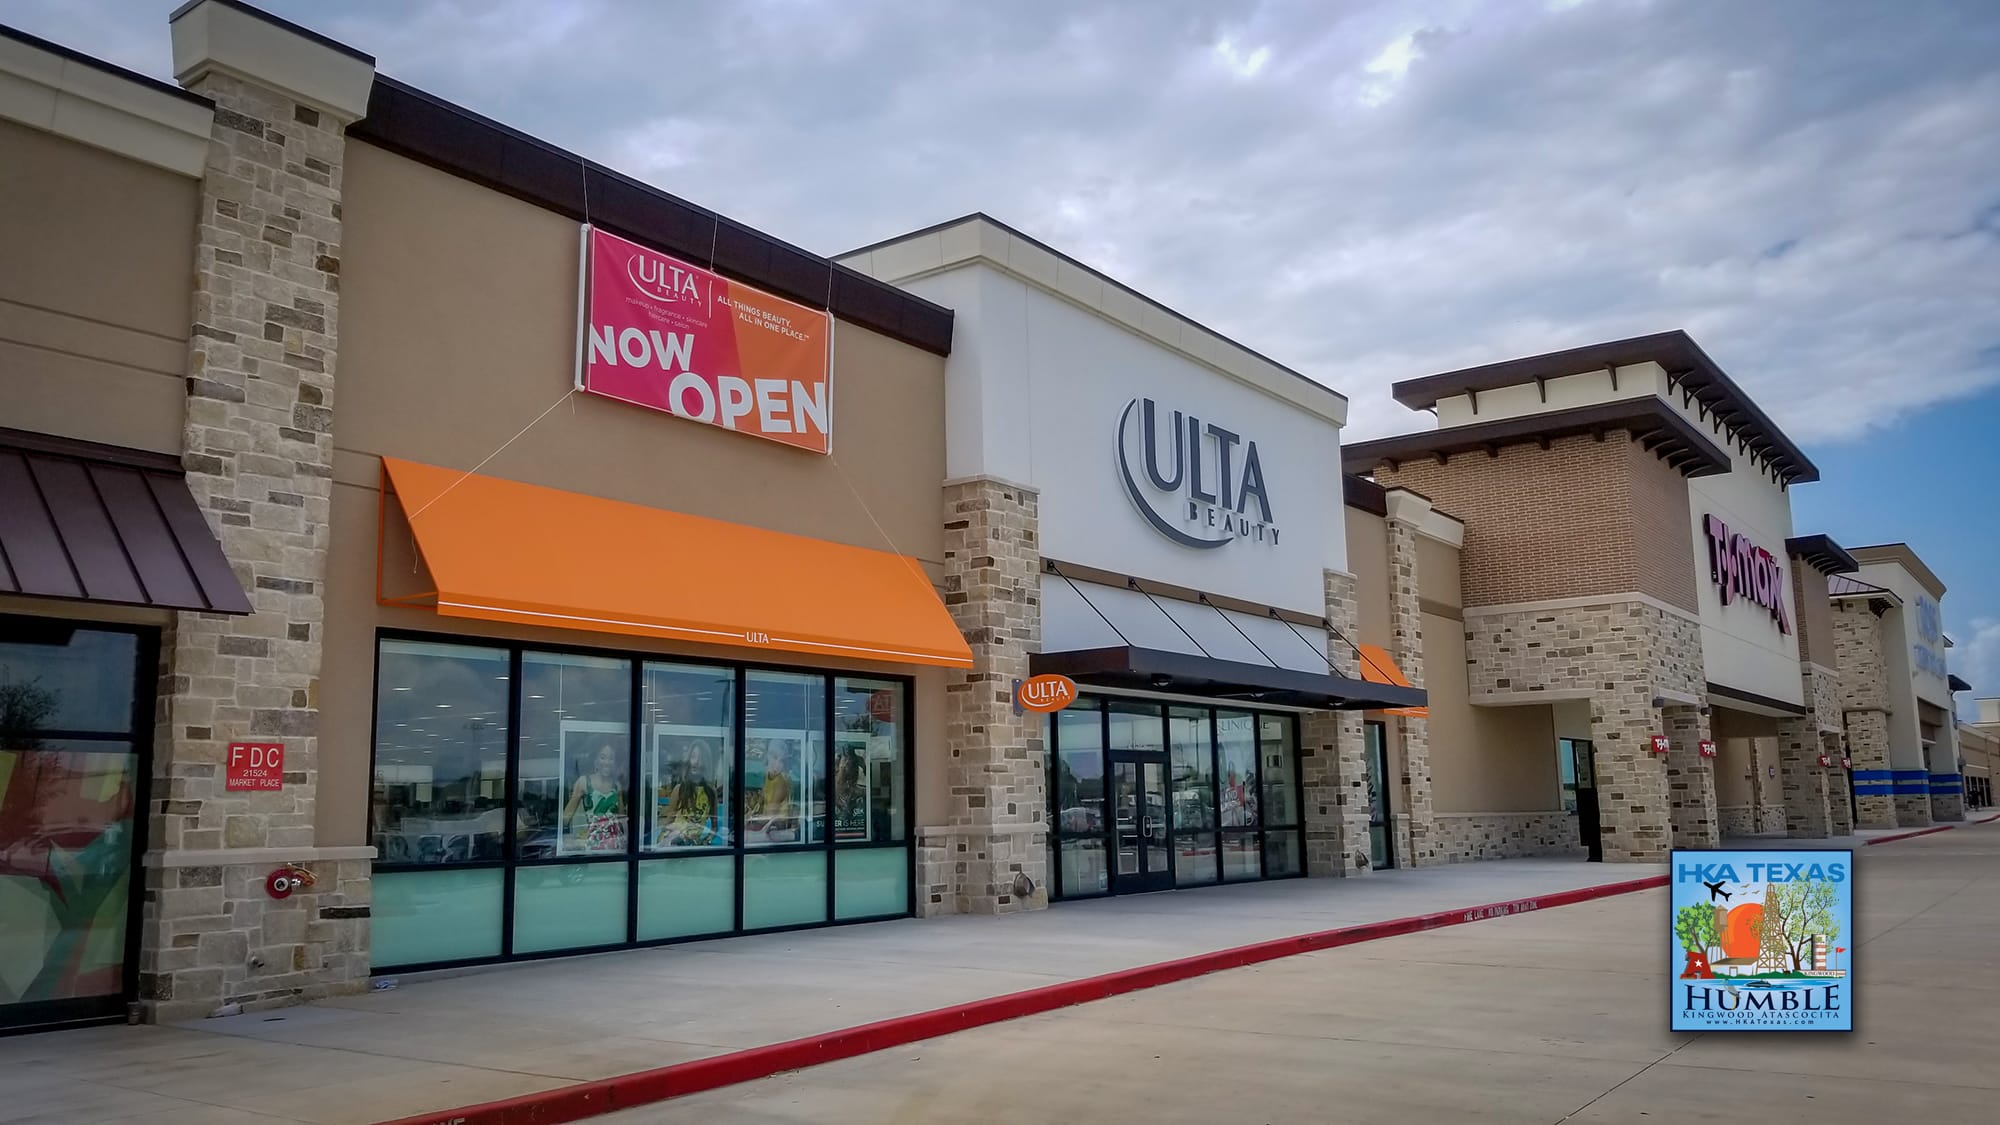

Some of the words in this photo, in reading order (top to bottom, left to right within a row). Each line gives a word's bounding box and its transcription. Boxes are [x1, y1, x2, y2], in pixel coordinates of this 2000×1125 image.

[639, 255, 699, 300] ULTA
[717, 295, 732, 307] ALL
[733, 300, 761, 317] THINGS
[762, 311, 792, 328] BEAUTY.
[738, 312, 753, 324] ALL
[754, 318, 762, 327] IN
[764, 321, 780, 333] ONE
[589, 323, 695, 372] NOW
[669, 372, 828, 435] OPEN
[1142, 397, 1274, 524] ULTA
[1188, 501, 1280, 546] BEAUTY
[746, 631, 769, 644] ULTA
[1028, 680, 1069, 700] ULTA
[229, 778, 257, 787] MARKET
[260, 778, 280, 787] PLACE
[242, 769, 268, 777] 21524
